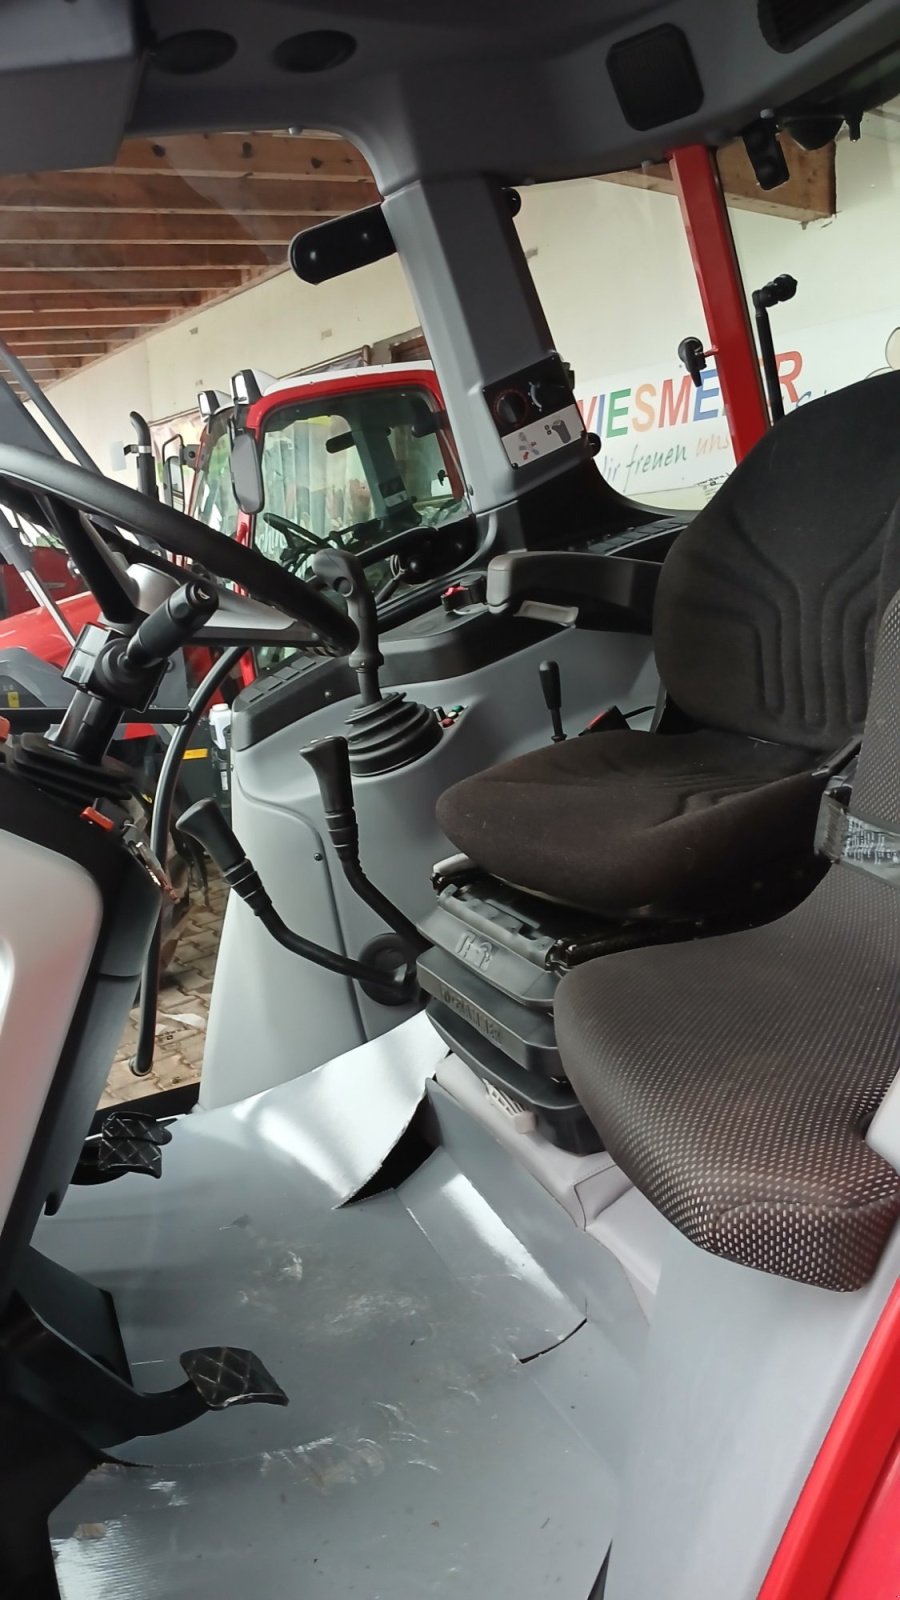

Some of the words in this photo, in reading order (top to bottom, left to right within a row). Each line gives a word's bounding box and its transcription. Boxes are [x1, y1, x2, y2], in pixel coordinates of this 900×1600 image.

[577, 350, 803, 438] IESMER
[602, 455, 621, 482] ir
[622, 443, 687, 494] freuen
